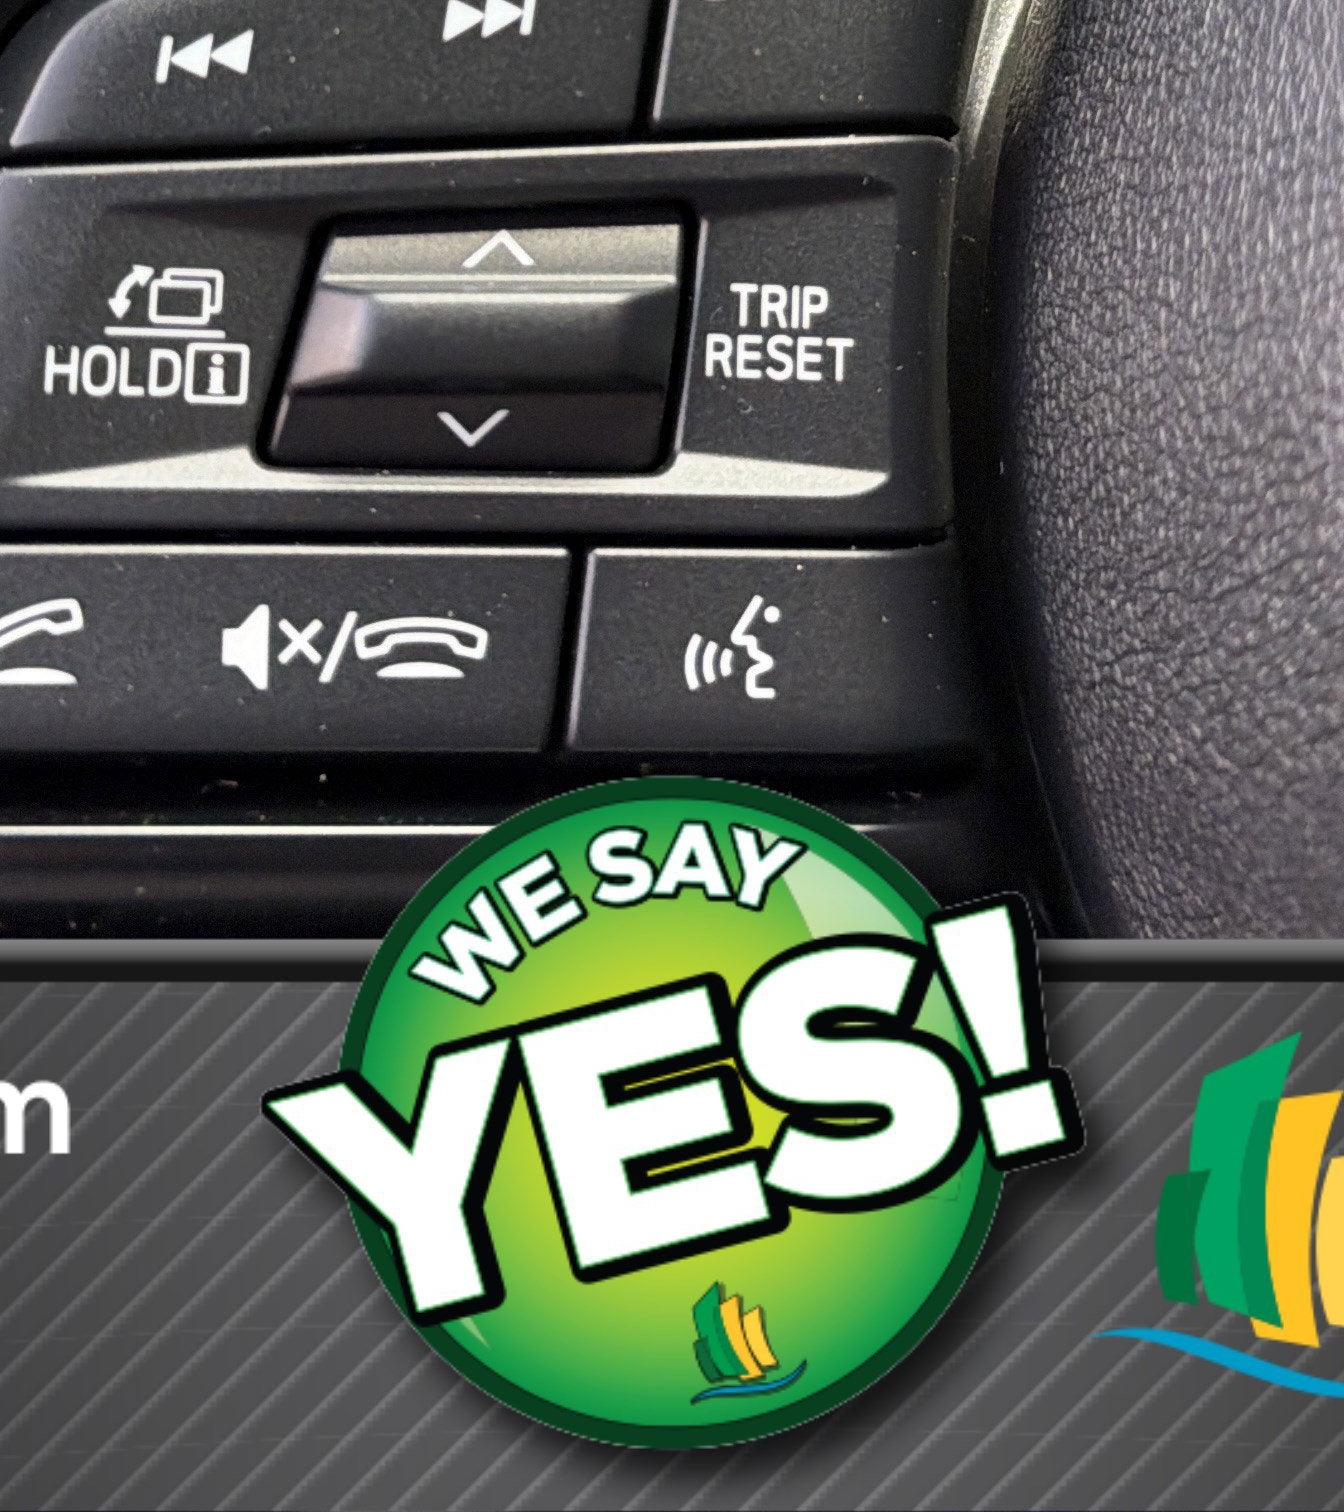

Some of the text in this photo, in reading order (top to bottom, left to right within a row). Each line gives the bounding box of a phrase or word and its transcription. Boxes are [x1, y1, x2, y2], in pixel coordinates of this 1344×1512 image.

[730, 282, 829, 329] TRIP
[43, 344, 183, 397] HOLD
[704, 333, 855, 382] RESET
